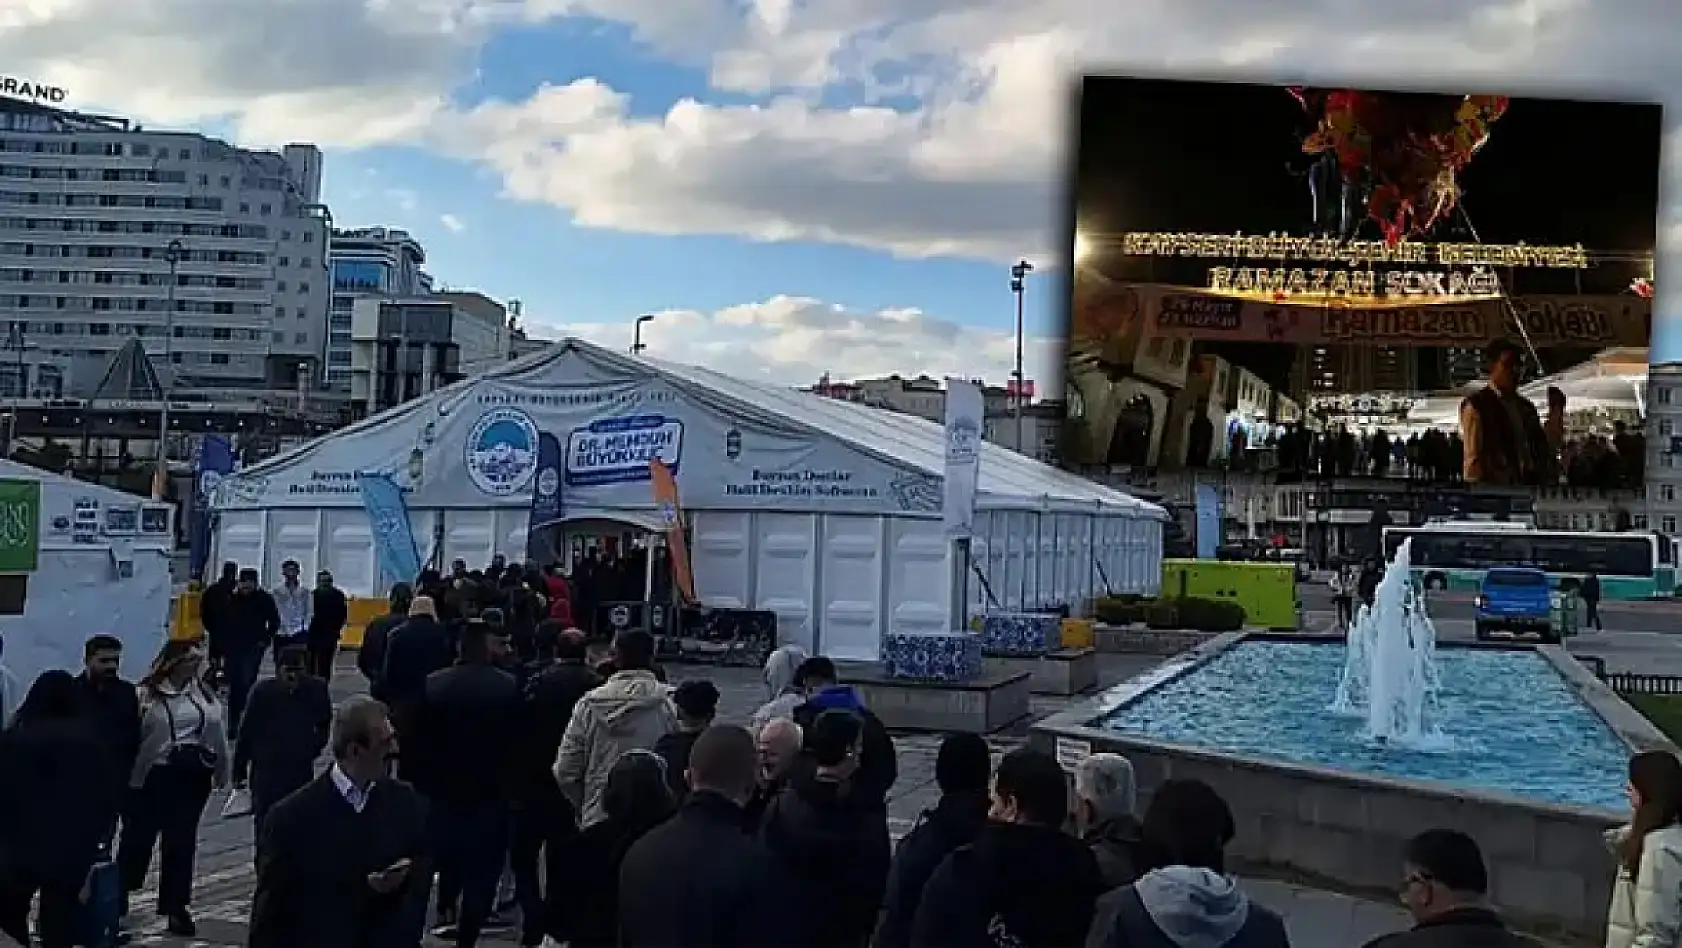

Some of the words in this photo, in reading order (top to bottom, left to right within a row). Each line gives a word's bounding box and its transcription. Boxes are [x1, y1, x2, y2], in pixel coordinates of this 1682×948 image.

[0, 76, 66, 102] RAND
[1208, 266, 1375, 293] RAMAZAN
[1322, 302, 1488, 338] Ramazan
